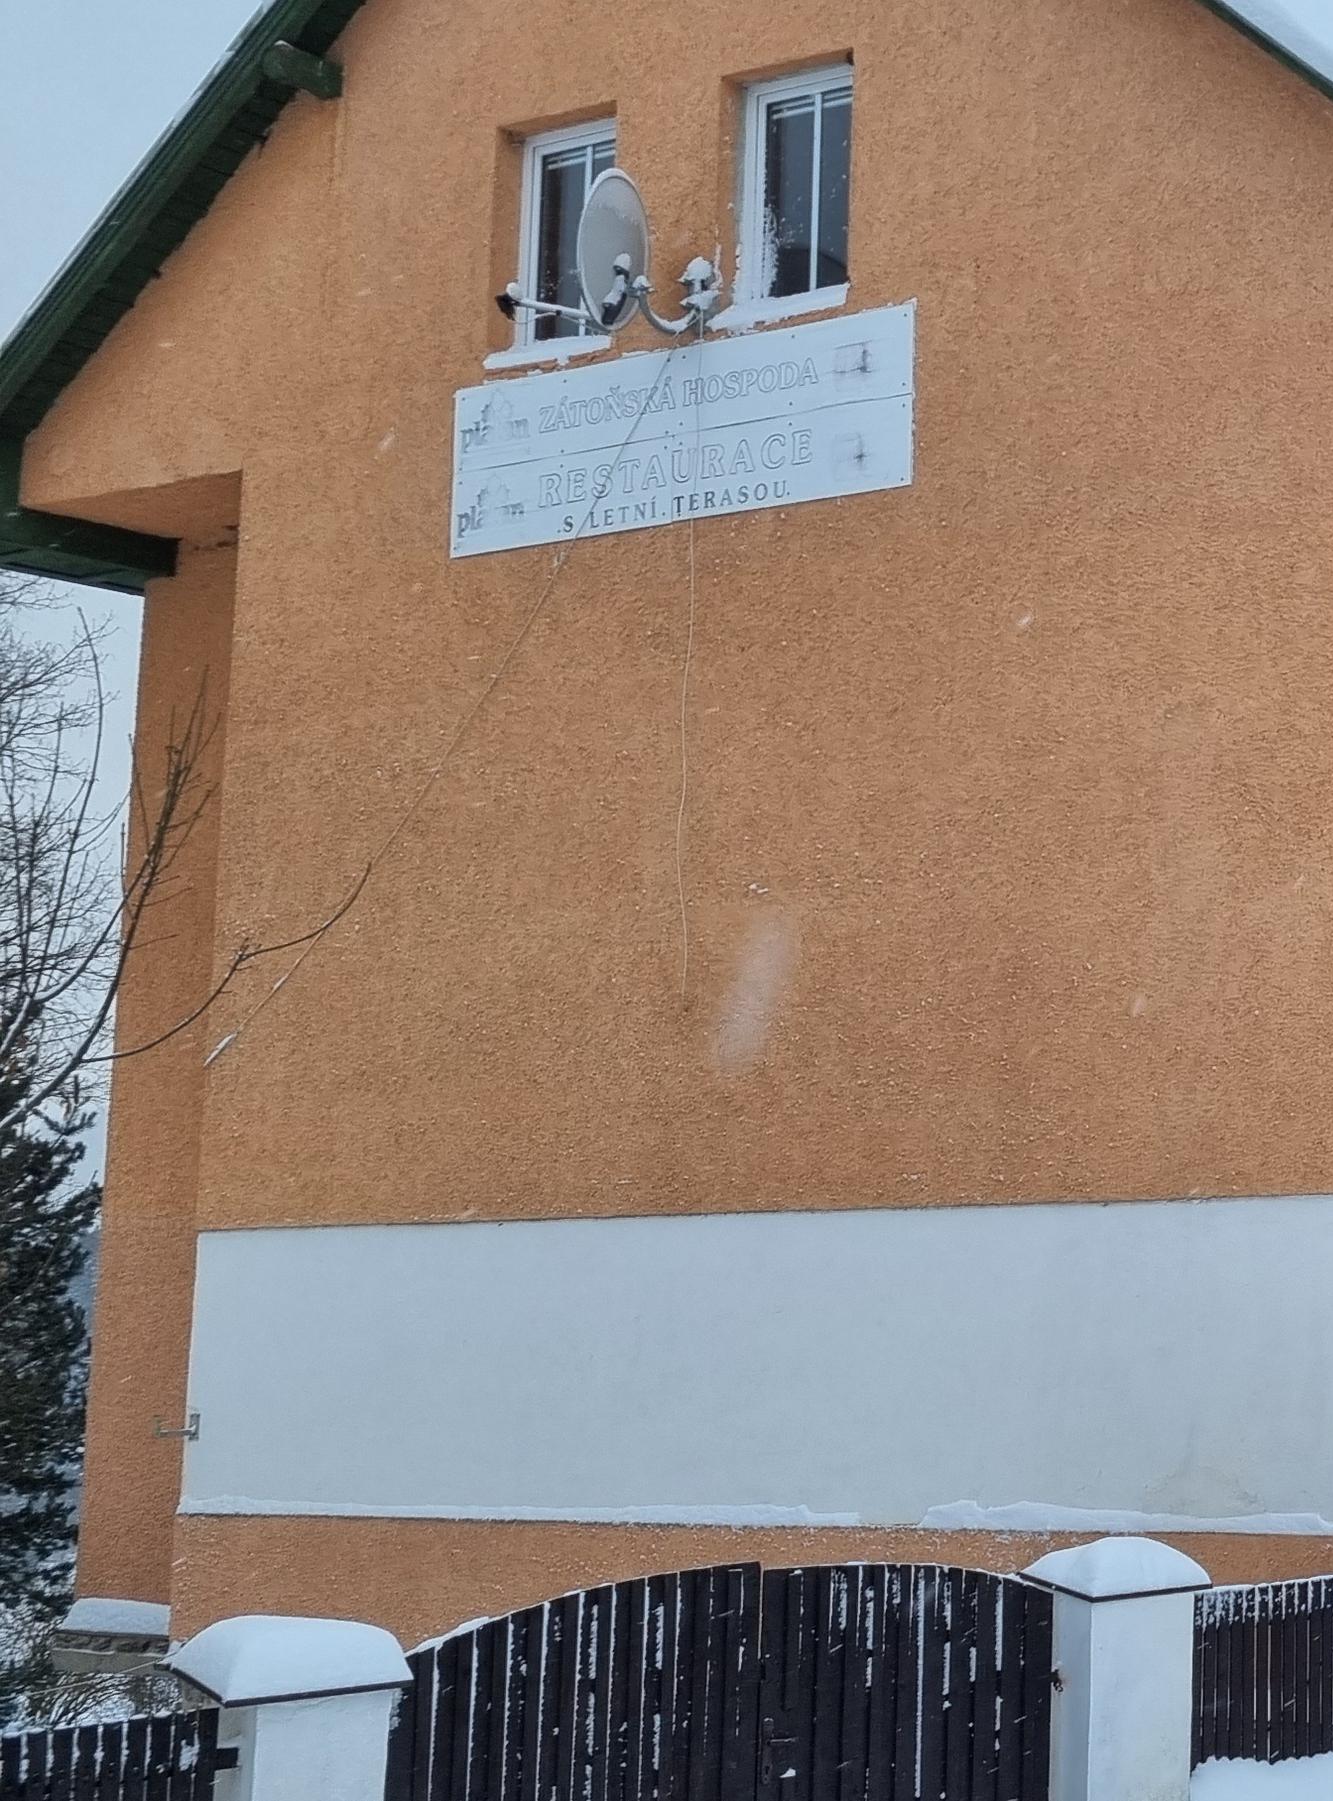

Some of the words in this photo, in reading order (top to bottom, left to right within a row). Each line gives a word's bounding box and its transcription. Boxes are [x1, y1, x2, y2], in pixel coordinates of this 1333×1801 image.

[538, 375, 676, 434] ZÁTOŇSKÁ
[682, 357, 818, 406] HOSPODA
[537, 428, 812, 508] RESTAURACE
